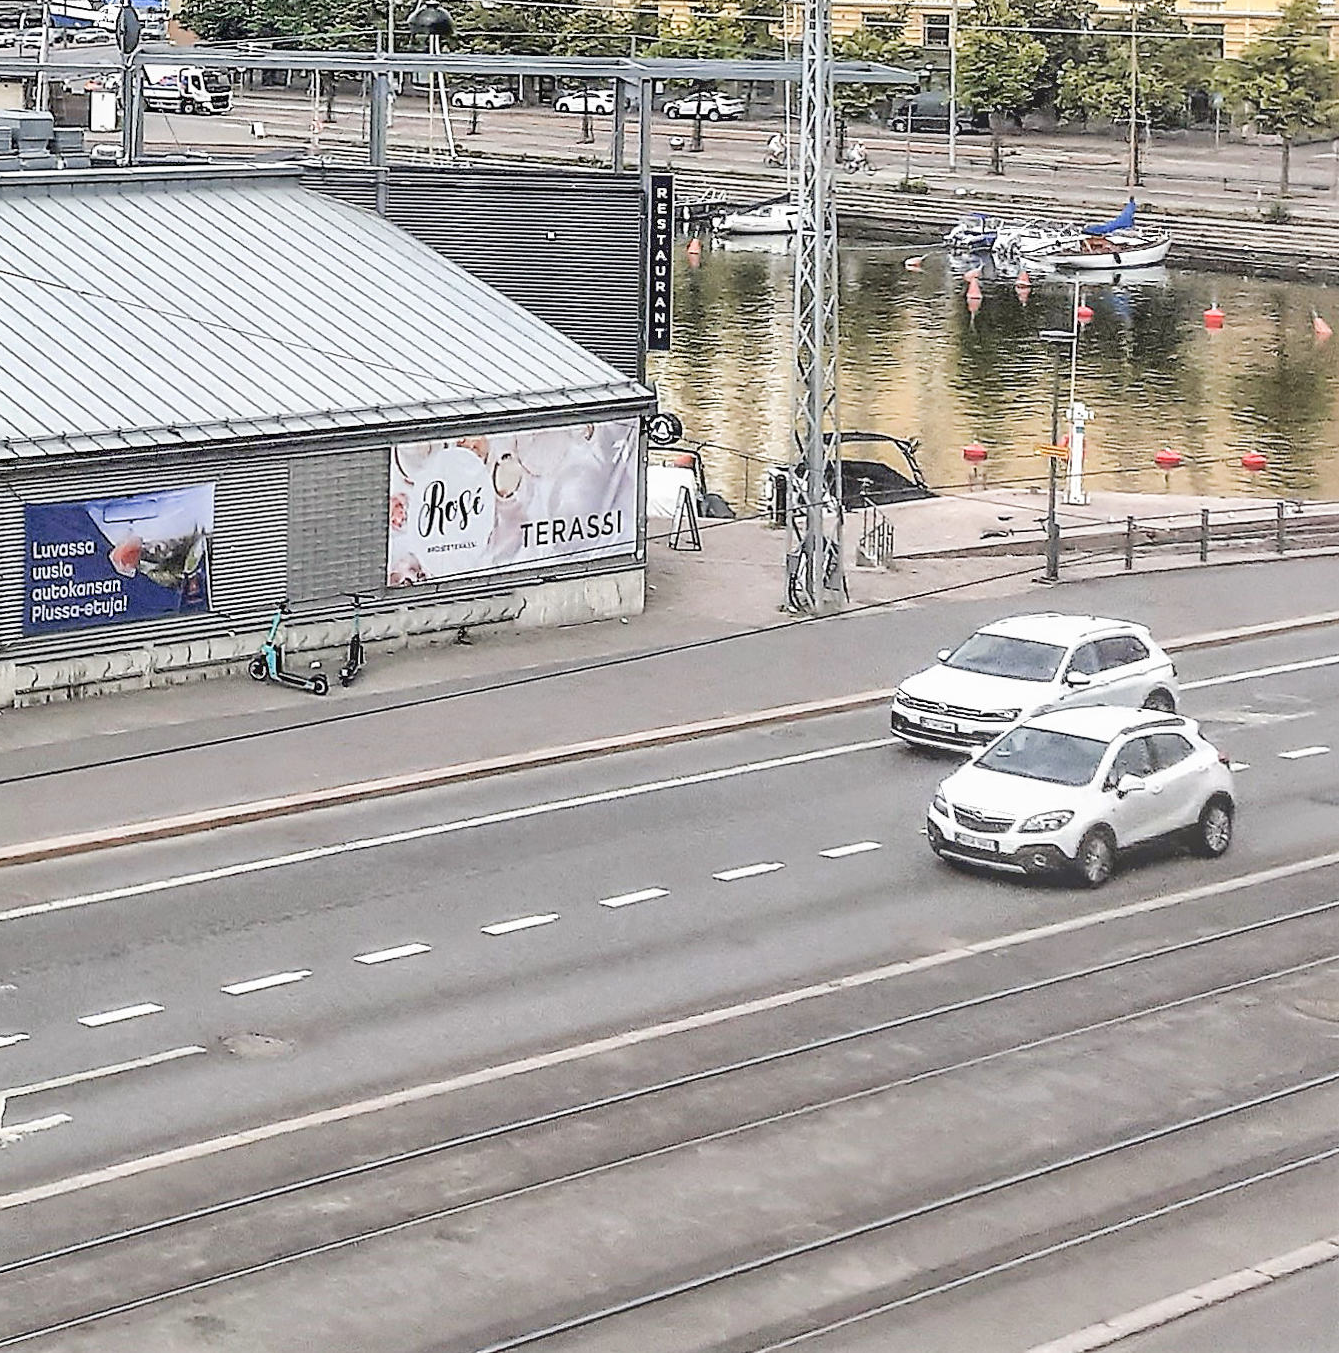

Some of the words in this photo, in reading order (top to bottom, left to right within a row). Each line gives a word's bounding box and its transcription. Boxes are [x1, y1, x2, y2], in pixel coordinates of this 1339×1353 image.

[654, 187, 669, 340] RESTAURANT
[417, 480, 484, 538] Rosé
[520, 509, 622, 548] TERASSI
[32, 540, 95, 559] Luvassa
[31, 579, 121, 602] autokansan
[31, 594, 128, 623] Plussa-etuja!
